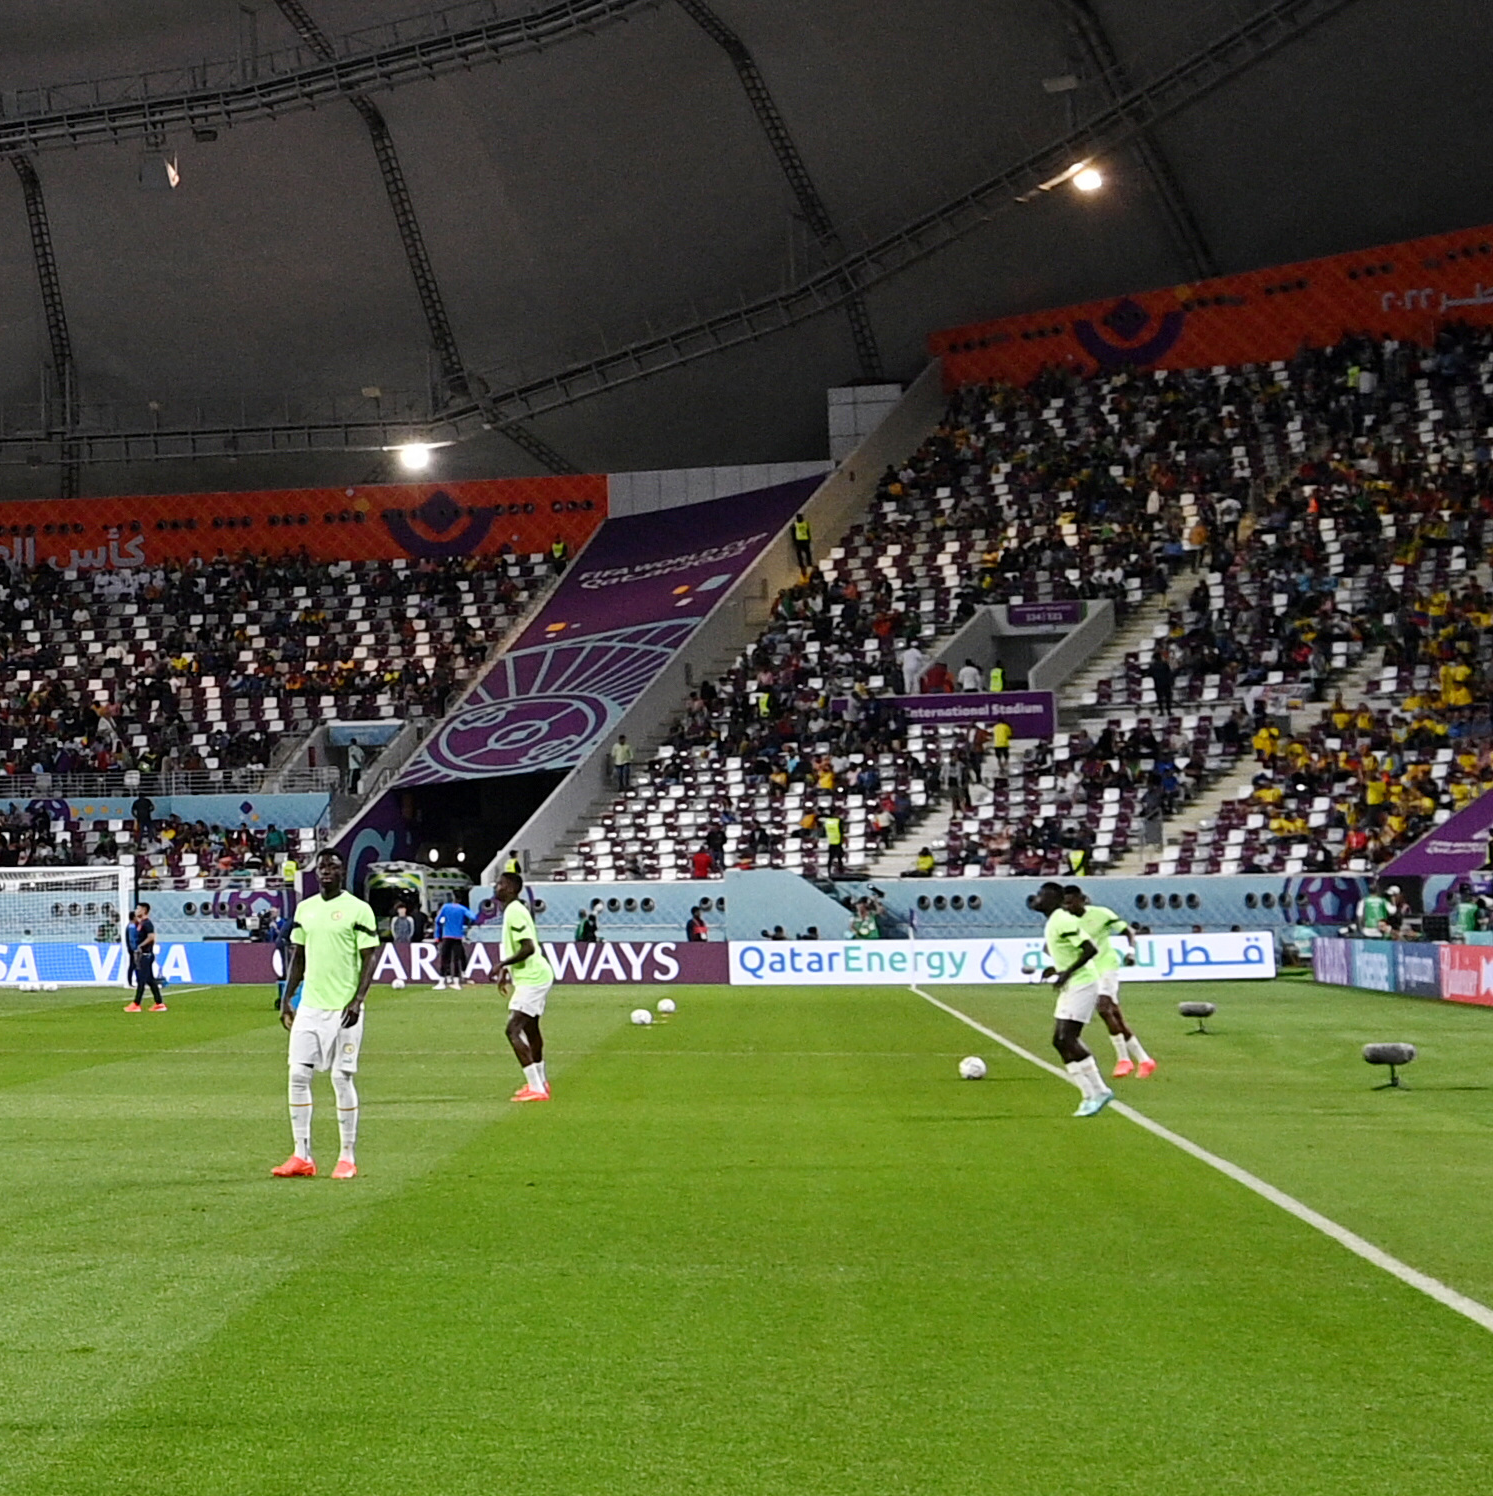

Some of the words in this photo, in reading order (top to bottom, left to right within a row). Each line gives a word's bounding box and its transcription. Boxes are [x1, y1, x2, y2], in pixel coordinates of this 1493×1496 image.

[47, 527, 146, 571] كأس
[991, 702, 1043, 716] Stadium
[739, 945, 967, 979] QatarEnergy
[1162, 936, 1264, 977] قطر
